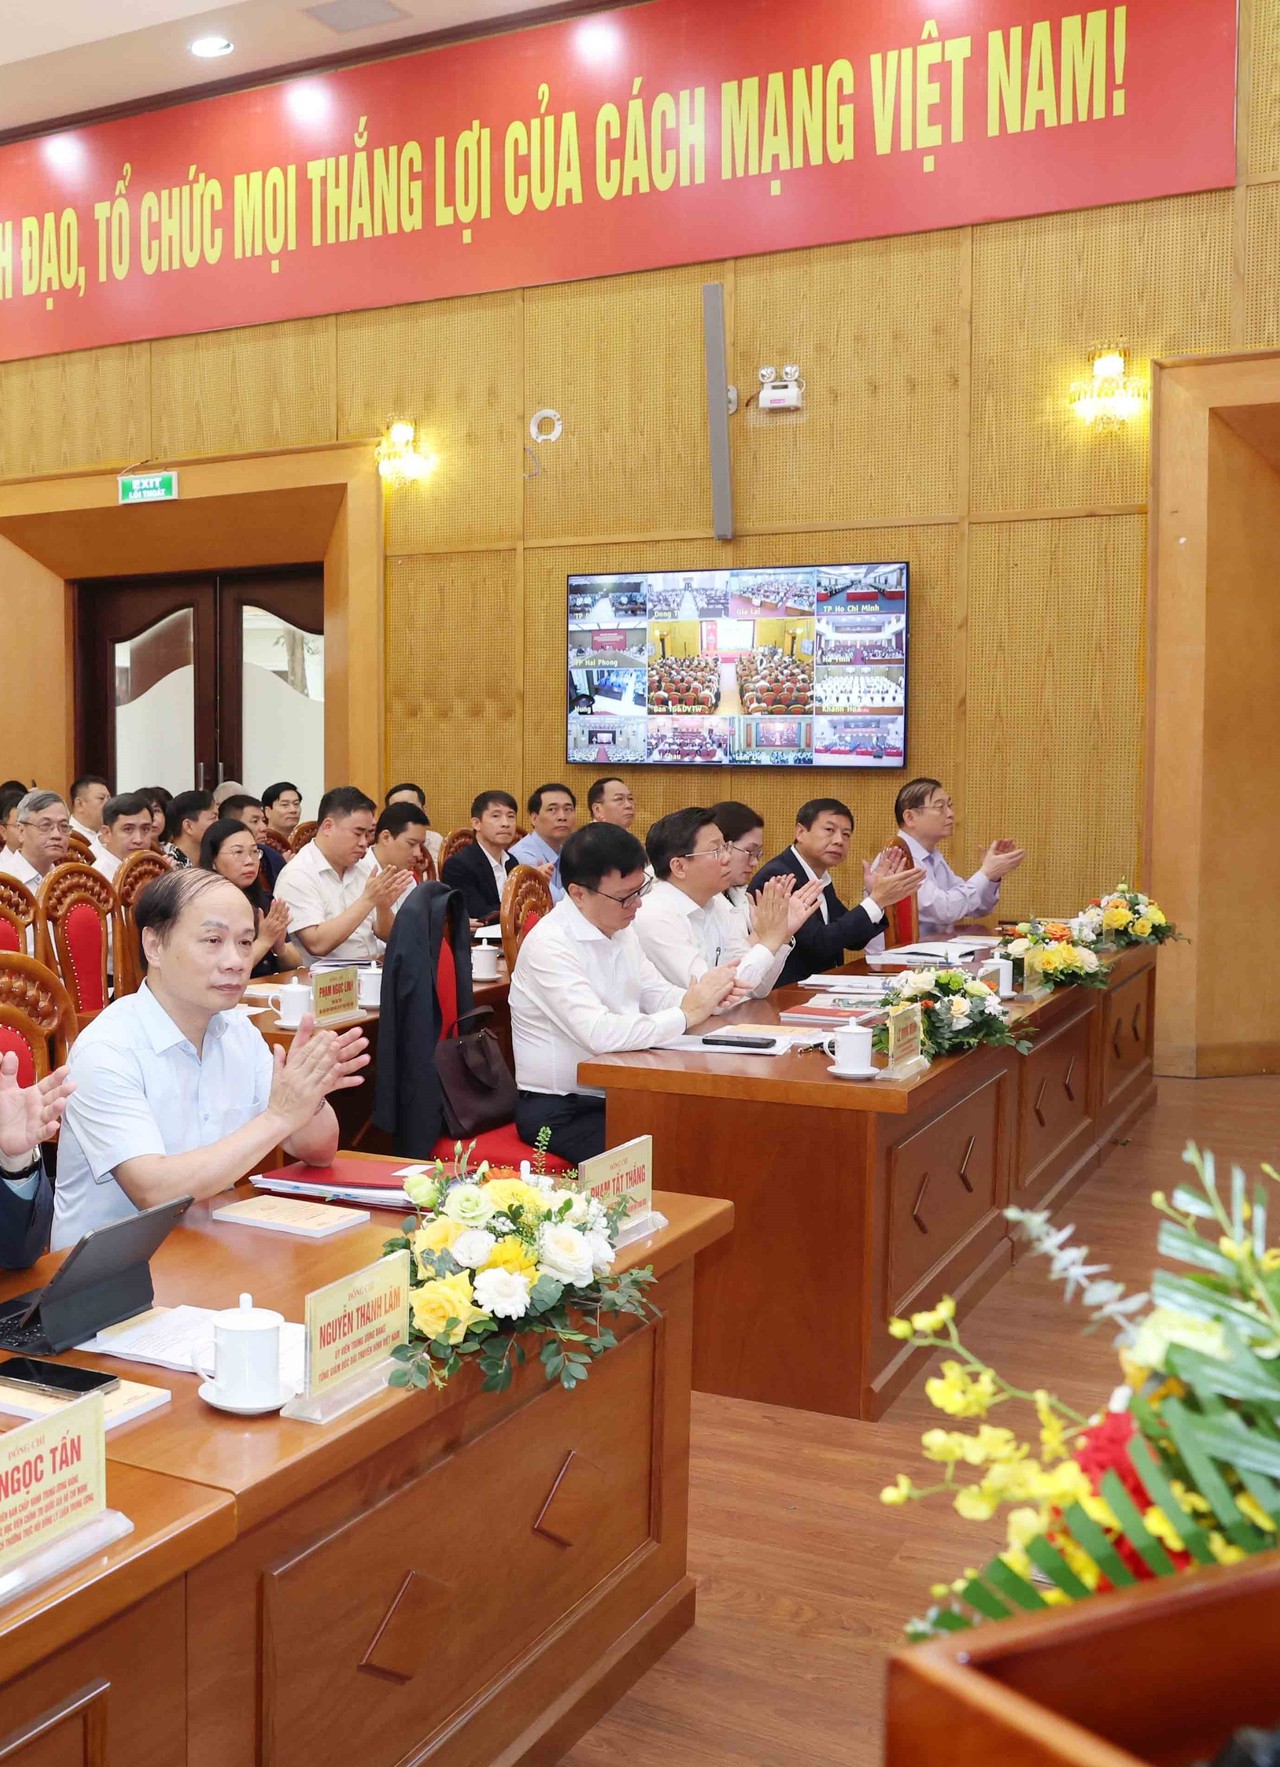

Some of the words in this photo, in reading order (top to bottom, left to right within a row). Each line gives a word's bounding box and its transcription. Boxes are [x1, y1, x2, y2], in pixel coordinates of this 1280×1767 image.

[21, 207, 86, 311] ĐẠO,
[94, 163, 132, 283] TỔ
[140, 164, 223, 275] CHỨC
[233, 163, 297, 274] MỌI
[306, 115, 422, 247] THẮNG
[435, 119, 491, 244] LỢI
[504, 82, 583, 216] CỦA
[595, 76, 706, 201] CÁCH
[721, 58, 855, 196] MẠNG
[869, 19, 972, 173] VIỆT
[987, 6, 1127, 137] NAM!
[132, 477, 162, 489] EXIT
[835, 605, 845, 613] Ho
[847, 604, 859, 612] Chi
[861, 604, 880, 612] Minh
[598, 659, 618, 667] Phong
[320, 1305, 354, 1350] NGUYỄN
[355, 1300, 382, 1331] THANH
[49, 1429, 81, 1475] TẤN
